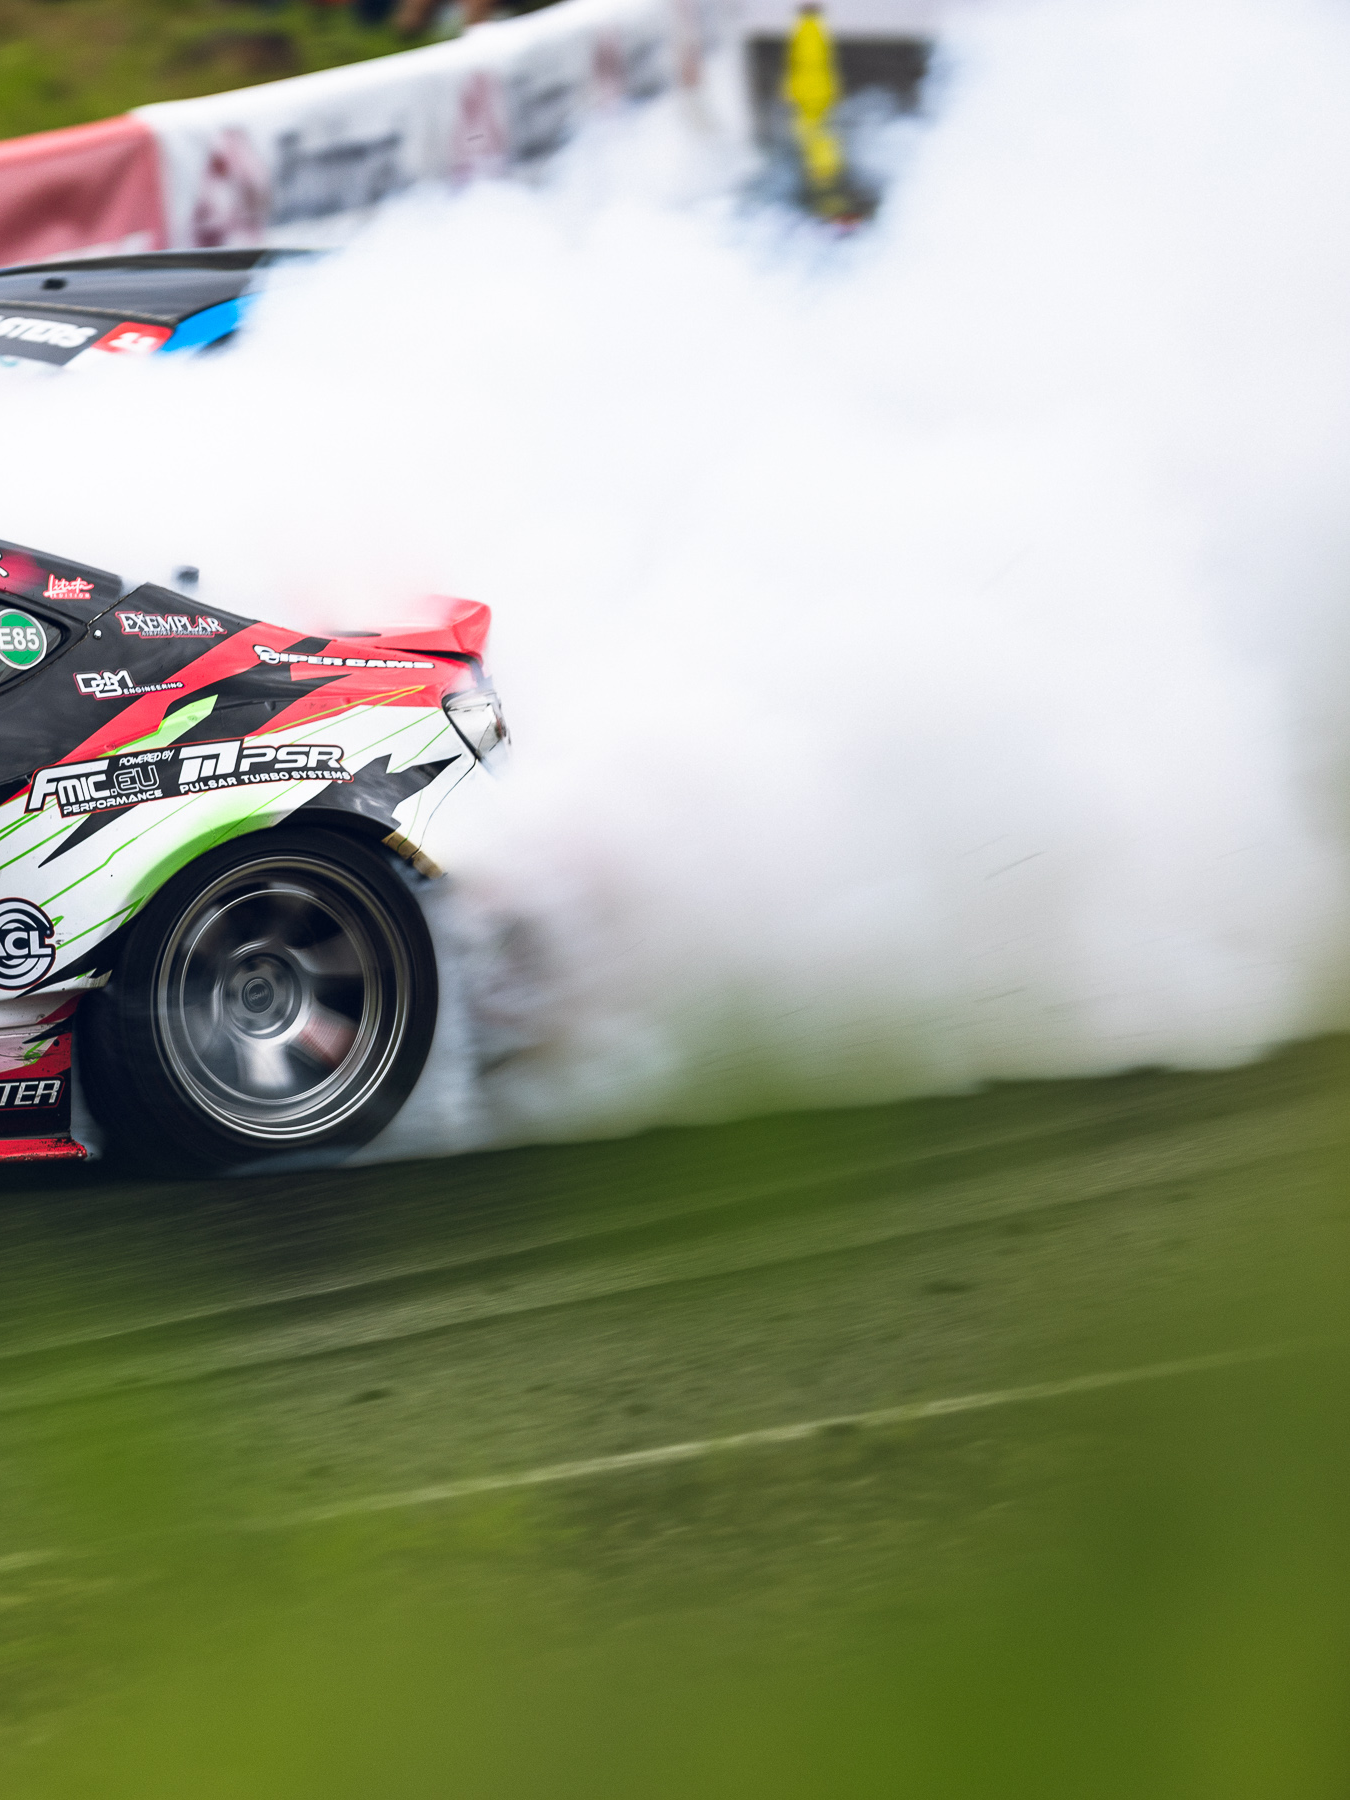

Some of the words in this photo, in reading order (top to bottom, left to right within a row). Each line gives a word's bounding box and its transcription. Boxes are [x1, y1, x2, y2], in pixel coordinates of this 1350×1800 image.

[118, 613, 225, 633] EXEMPLAR
[124, 682, 183, 695] ENGINEERING
[118, 751, 161, 767] POWERED
[180, 778, 237, 793] PULSAR
[242, 774, 289, 784] TURBO
[292, 770, 350, 780] SYSTEMS
[63, 789, 163, 815] PERFORMANCE
